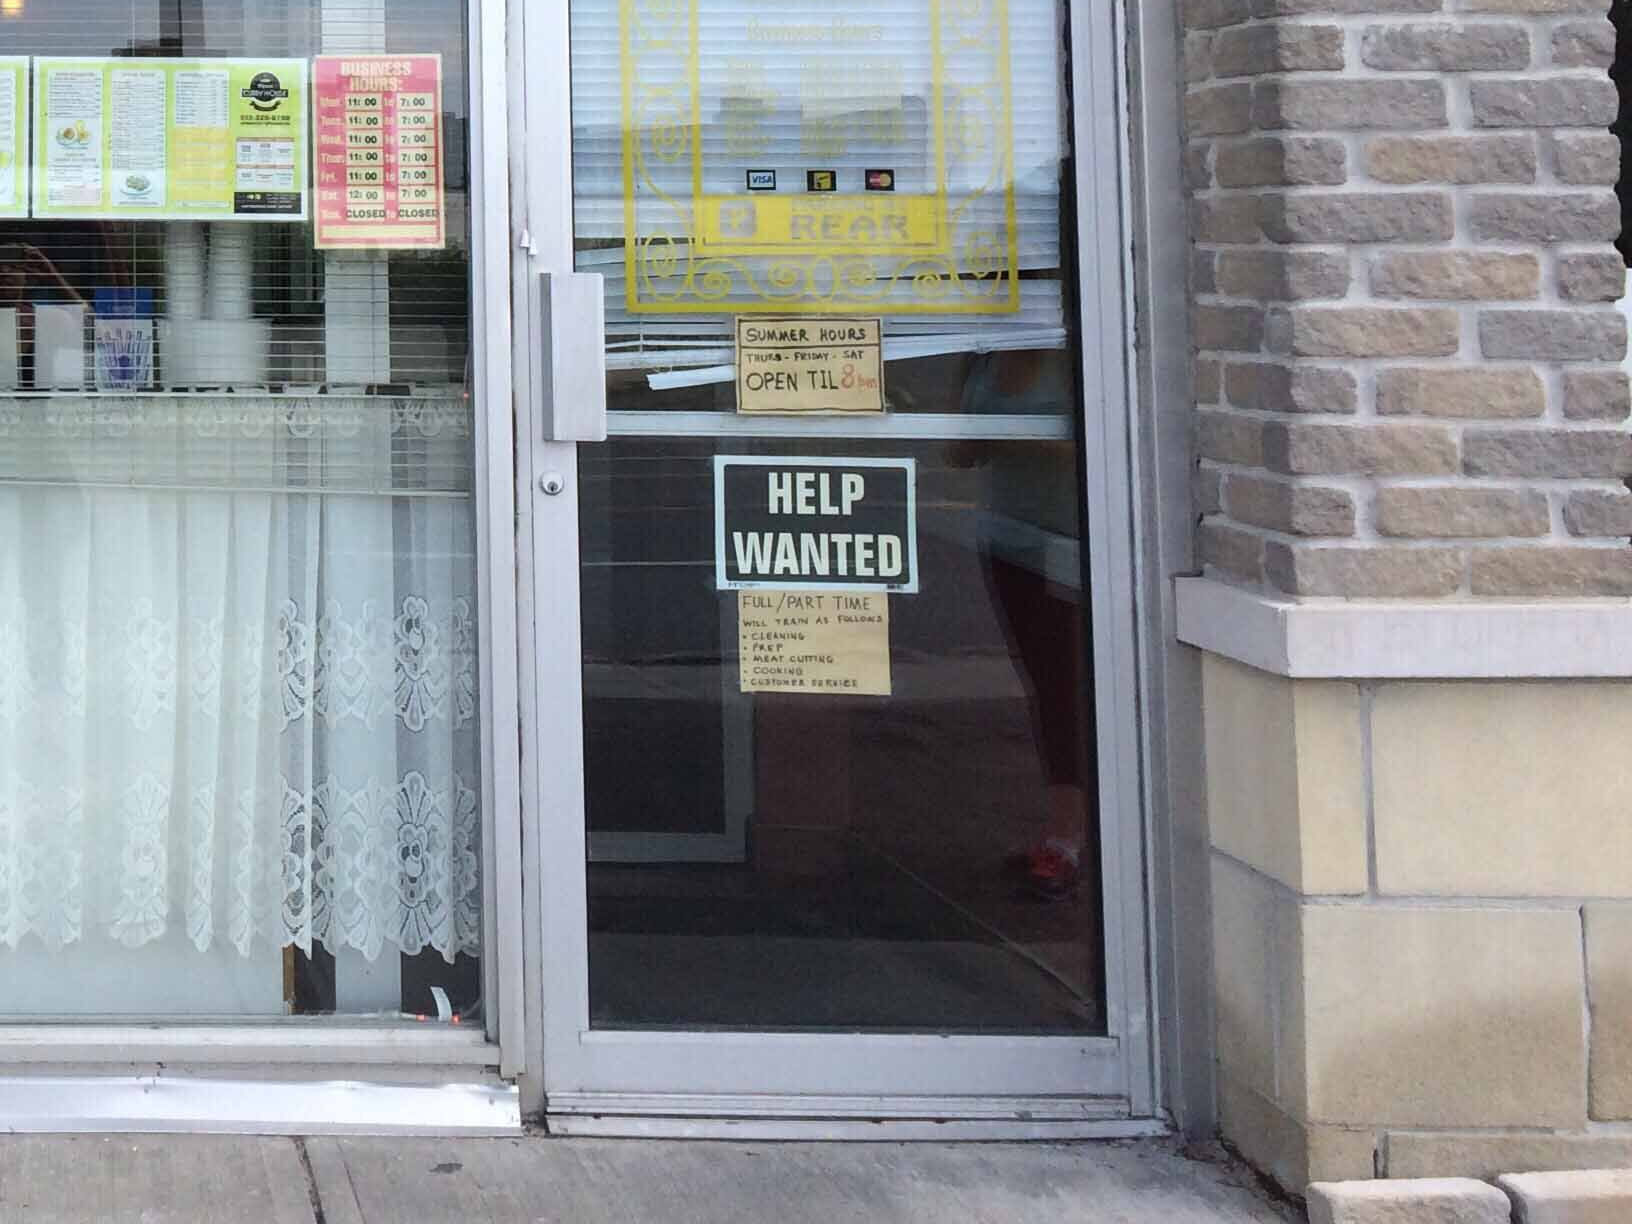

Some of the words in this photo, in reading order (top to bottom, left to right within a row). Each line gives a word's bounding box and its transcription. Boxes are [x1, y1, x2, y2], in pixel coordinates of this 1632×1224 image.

[340, 61, 412, 76] BUSINESS
[751, 172, 773, 184] VISA
[346, 209, 386, 218] CLOSED
[398, 208, 440, 218] CLOSED
[790, 214, 909, 240] REAR
[745, 328, 809, 343] SUMMER
[820, 327, 866, 341] HOURS
[794, 351, 829, 362] FRIDAY
[842, 350, 865, 361] SAT
[746, 371, 799, 392] OPEN
[807, 369, 839, 391] TIL
[768, 471, 865, 516] HELP
[732, 531, 903, 577] WANTED
[832, 595, 873, 611] TIME
[743, 618, 769, 628] WILL
[776, 617, 809, 626] TRAIN
[816, 616, 829, 625] AS
[751, 633, 806, 642] CLEANING
[752, 643, 784, 653] PREP
[753, 655, 785, 664] MEAT
[789, 655, 835, 665] CUTTING
[752, 666, 804, 676] COOKING
[750, 678, 806, 688] CUSTOMER
[811, 678, 859, 688] SERVICE
